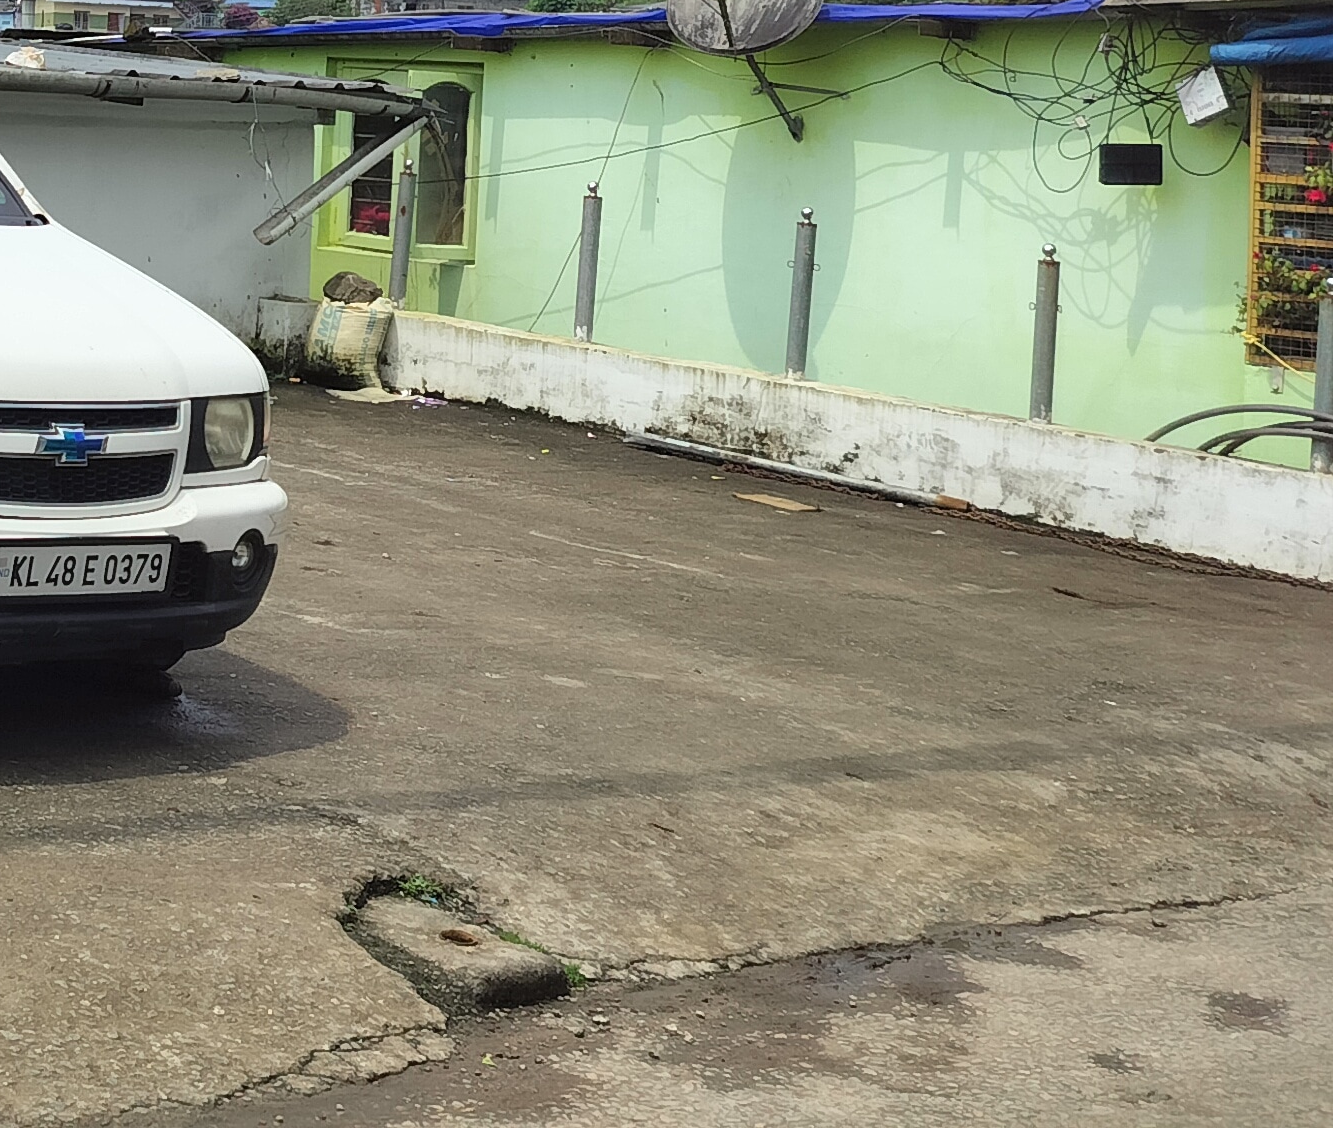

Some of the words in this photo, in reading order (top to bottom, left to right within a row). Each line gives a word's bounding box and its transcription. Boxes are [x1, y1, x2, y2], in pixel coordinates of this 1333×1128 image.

[9, 555, 39, 587] KL
[45, 555, 77, 587] 48
[82, 554, 100, 587] E
[103, 553, 163, 585] 0379
